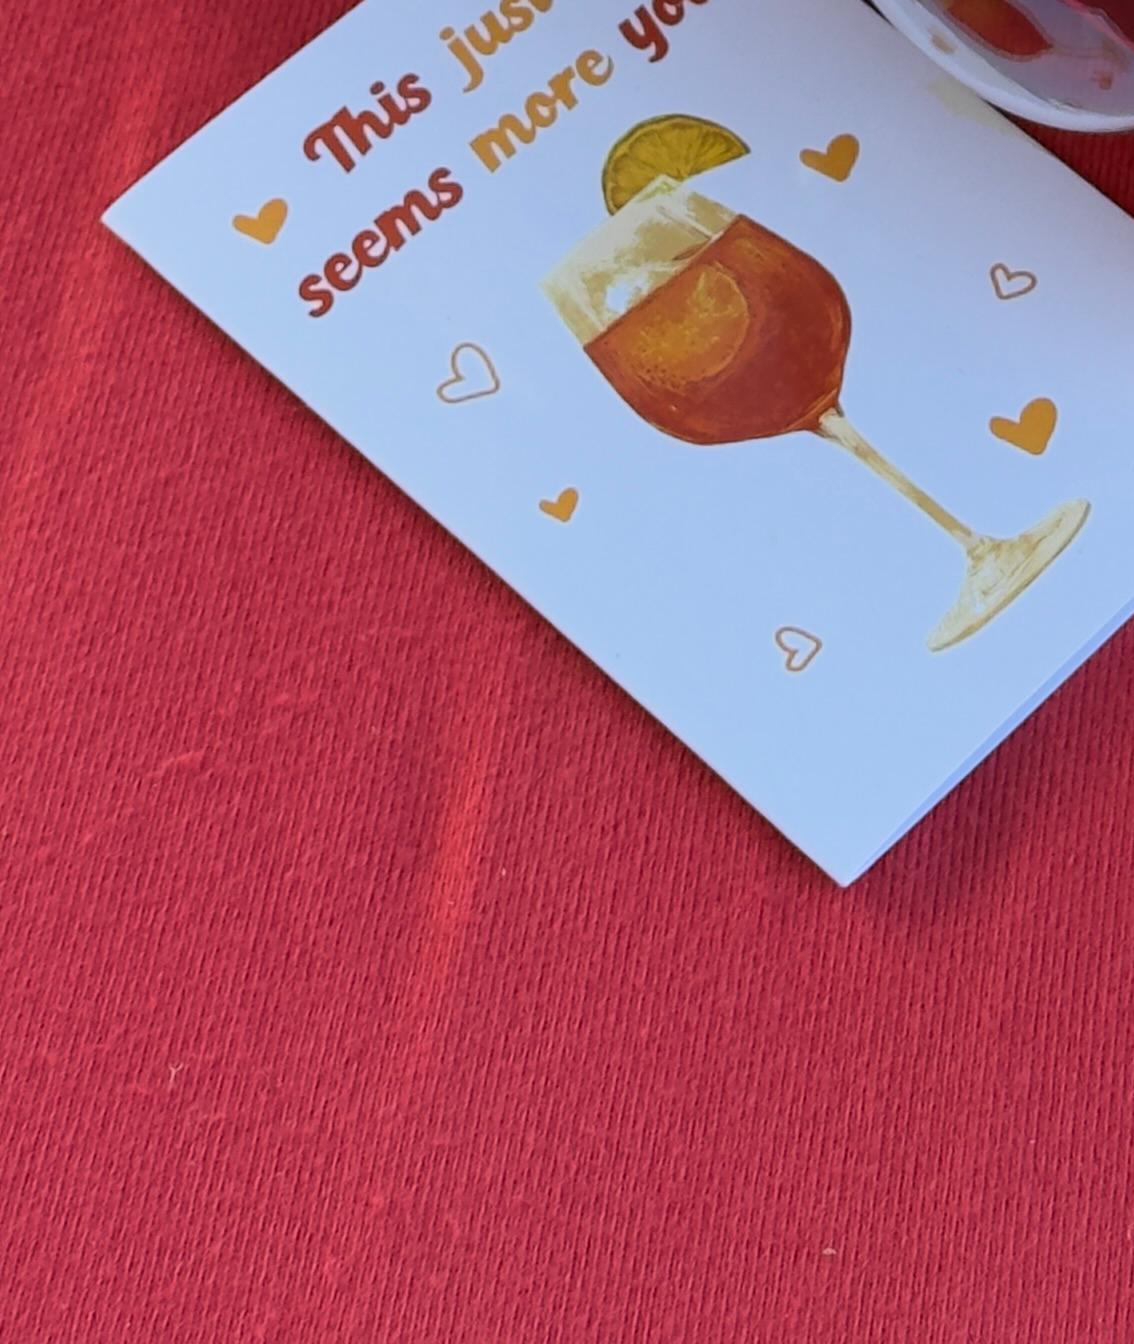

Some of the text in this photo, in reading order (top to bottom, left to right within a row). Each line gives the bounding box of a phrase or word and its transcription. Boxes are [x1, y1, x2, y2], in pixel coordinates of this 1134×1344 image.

[298, 166, 464, 318] seems
[469, 49, 615, 173] more
[303, 72, 432, 173] This
